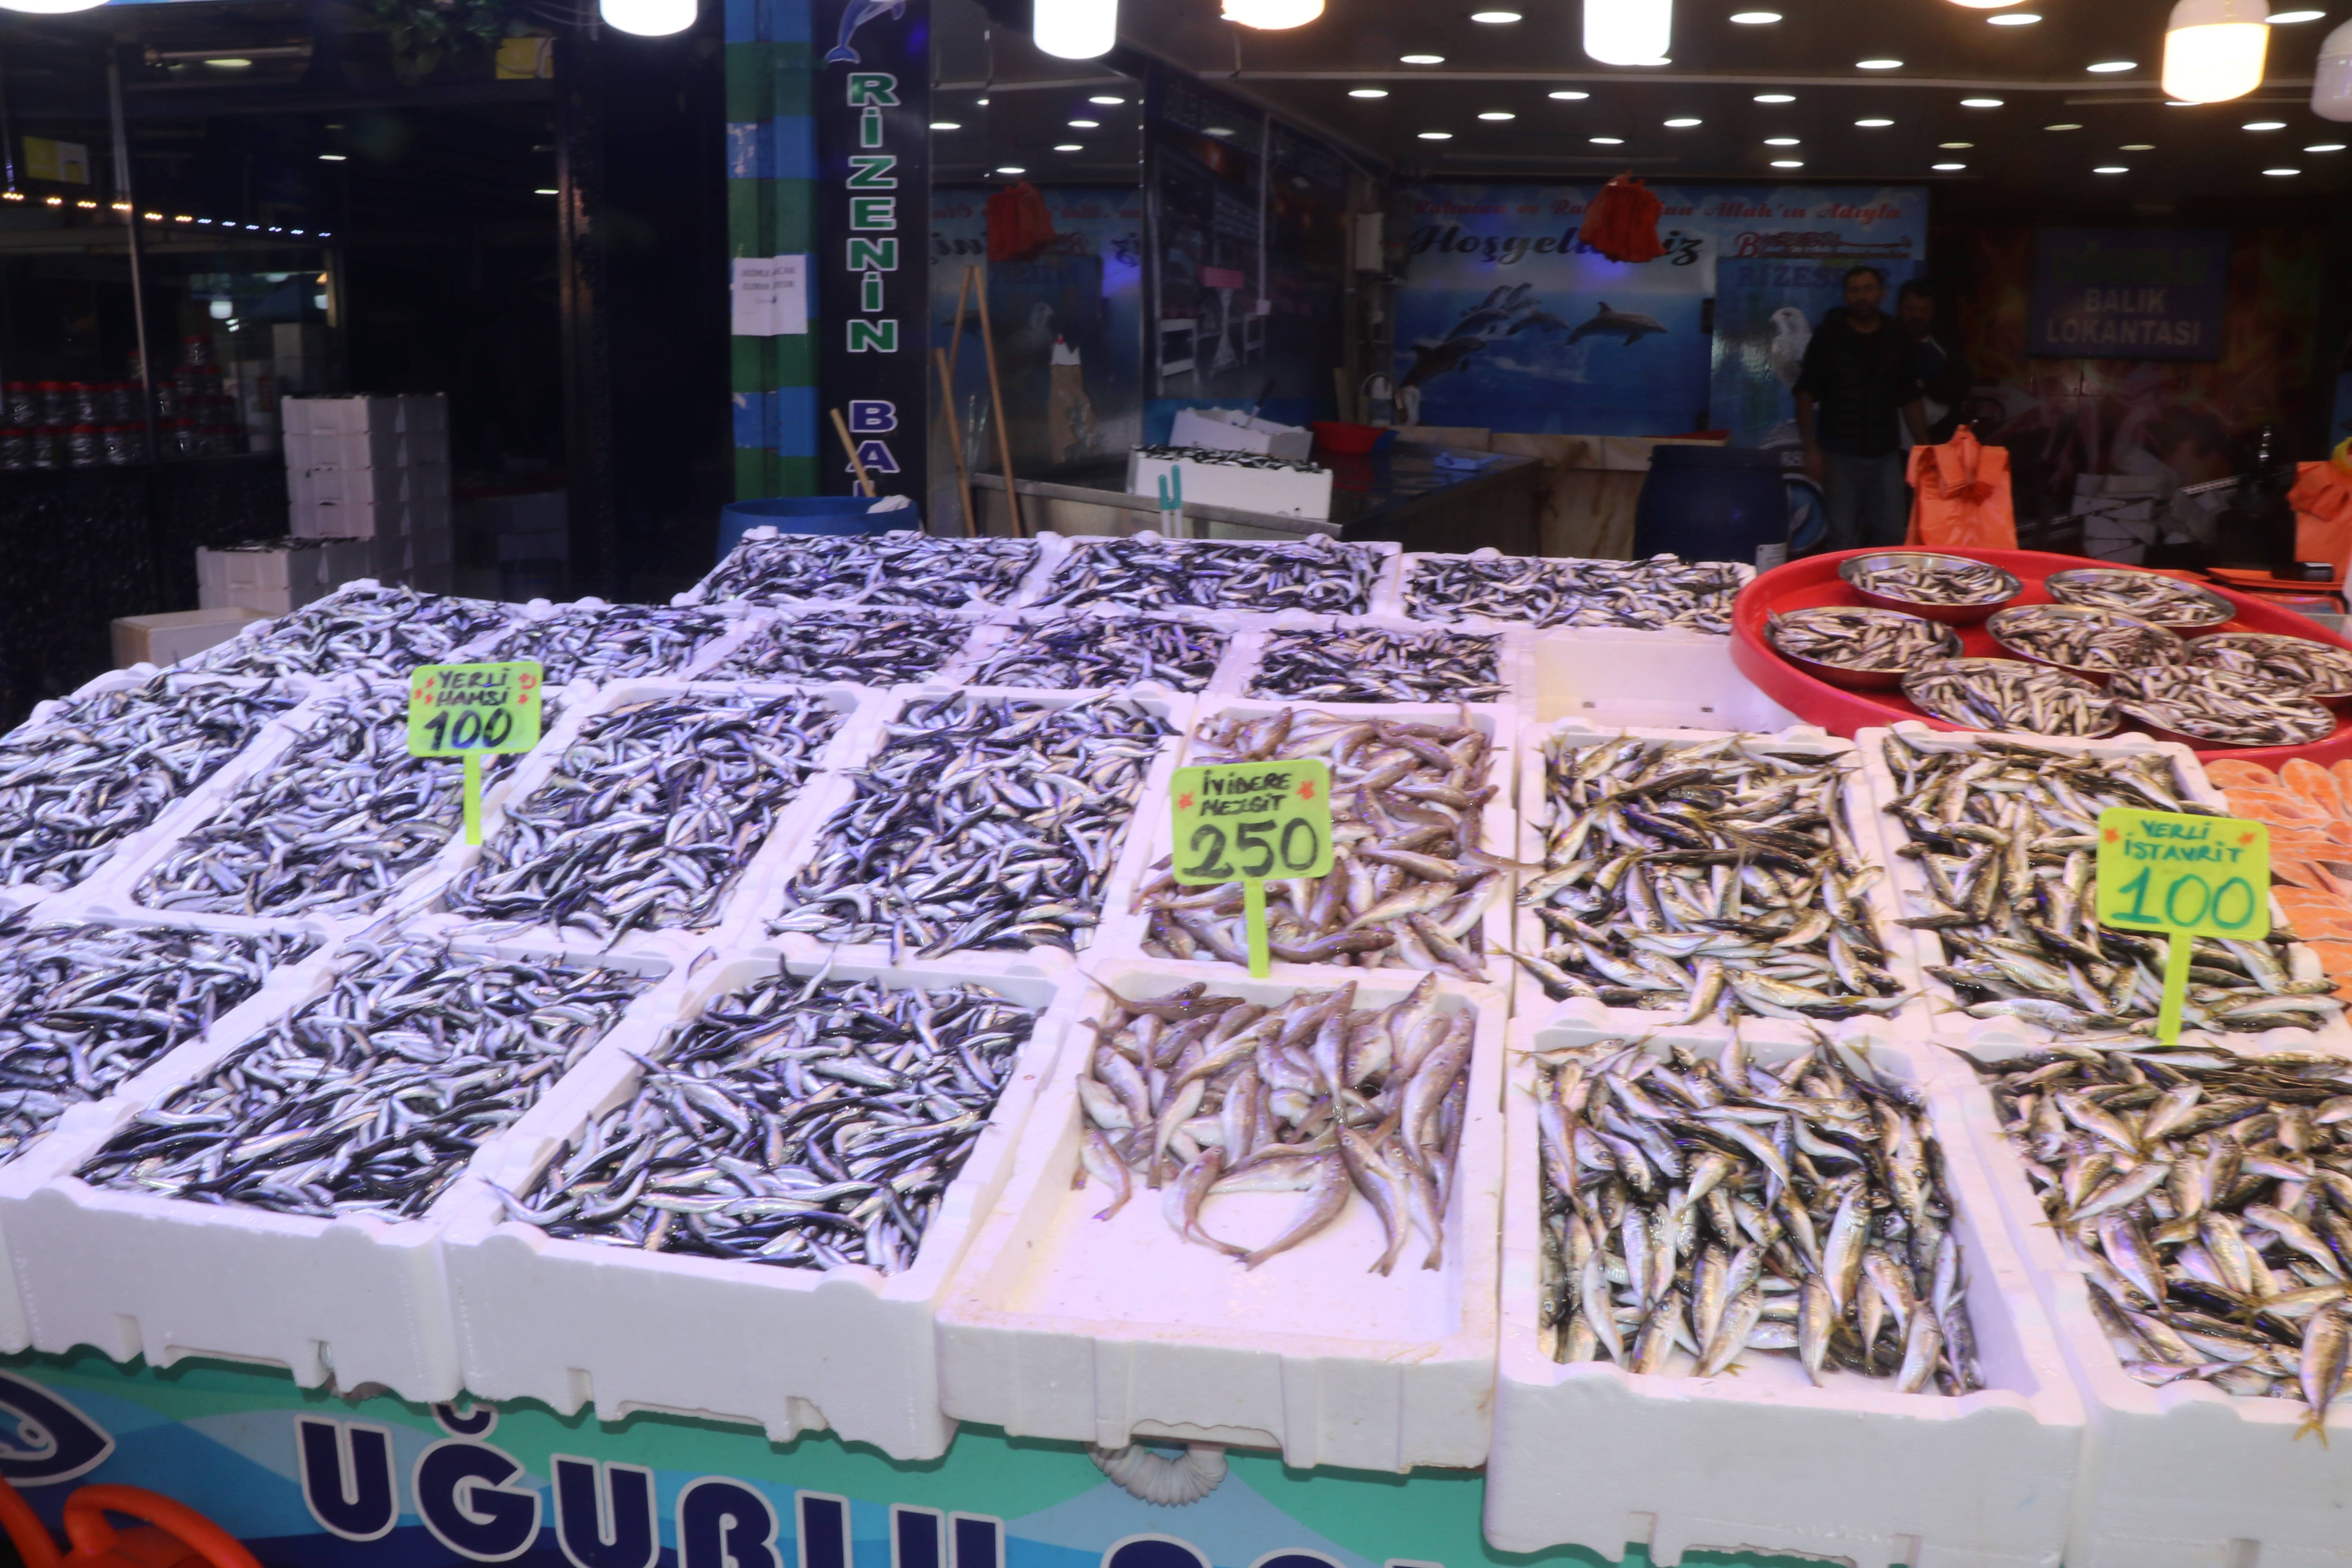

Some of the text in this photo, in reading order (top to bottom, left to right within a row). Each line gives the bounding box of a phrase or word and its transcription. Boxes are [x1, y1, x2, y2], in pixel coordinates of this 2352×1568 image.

[846, 72, 901, 354] RİZENİN
[1518, 204, 1540, 215] ve
[1410, 225, 1703, 266] Hoşgeliz
[2084, 288, 2168, 313] BALIK
[2045, 318, 2202, 346] LOKANTASI
[438, 668, 511, 689] YERLİ
[436, 687, 511, 707] HAMSİ
[424, 707, 513, 751] 100
[2140, 819, 2213, 840] YERLİ
[1182, 817, 1318, 878] 250
[2124, 831, 2245, 863] İSTAVRİT
[2111, 866, 2256, 930] 100
